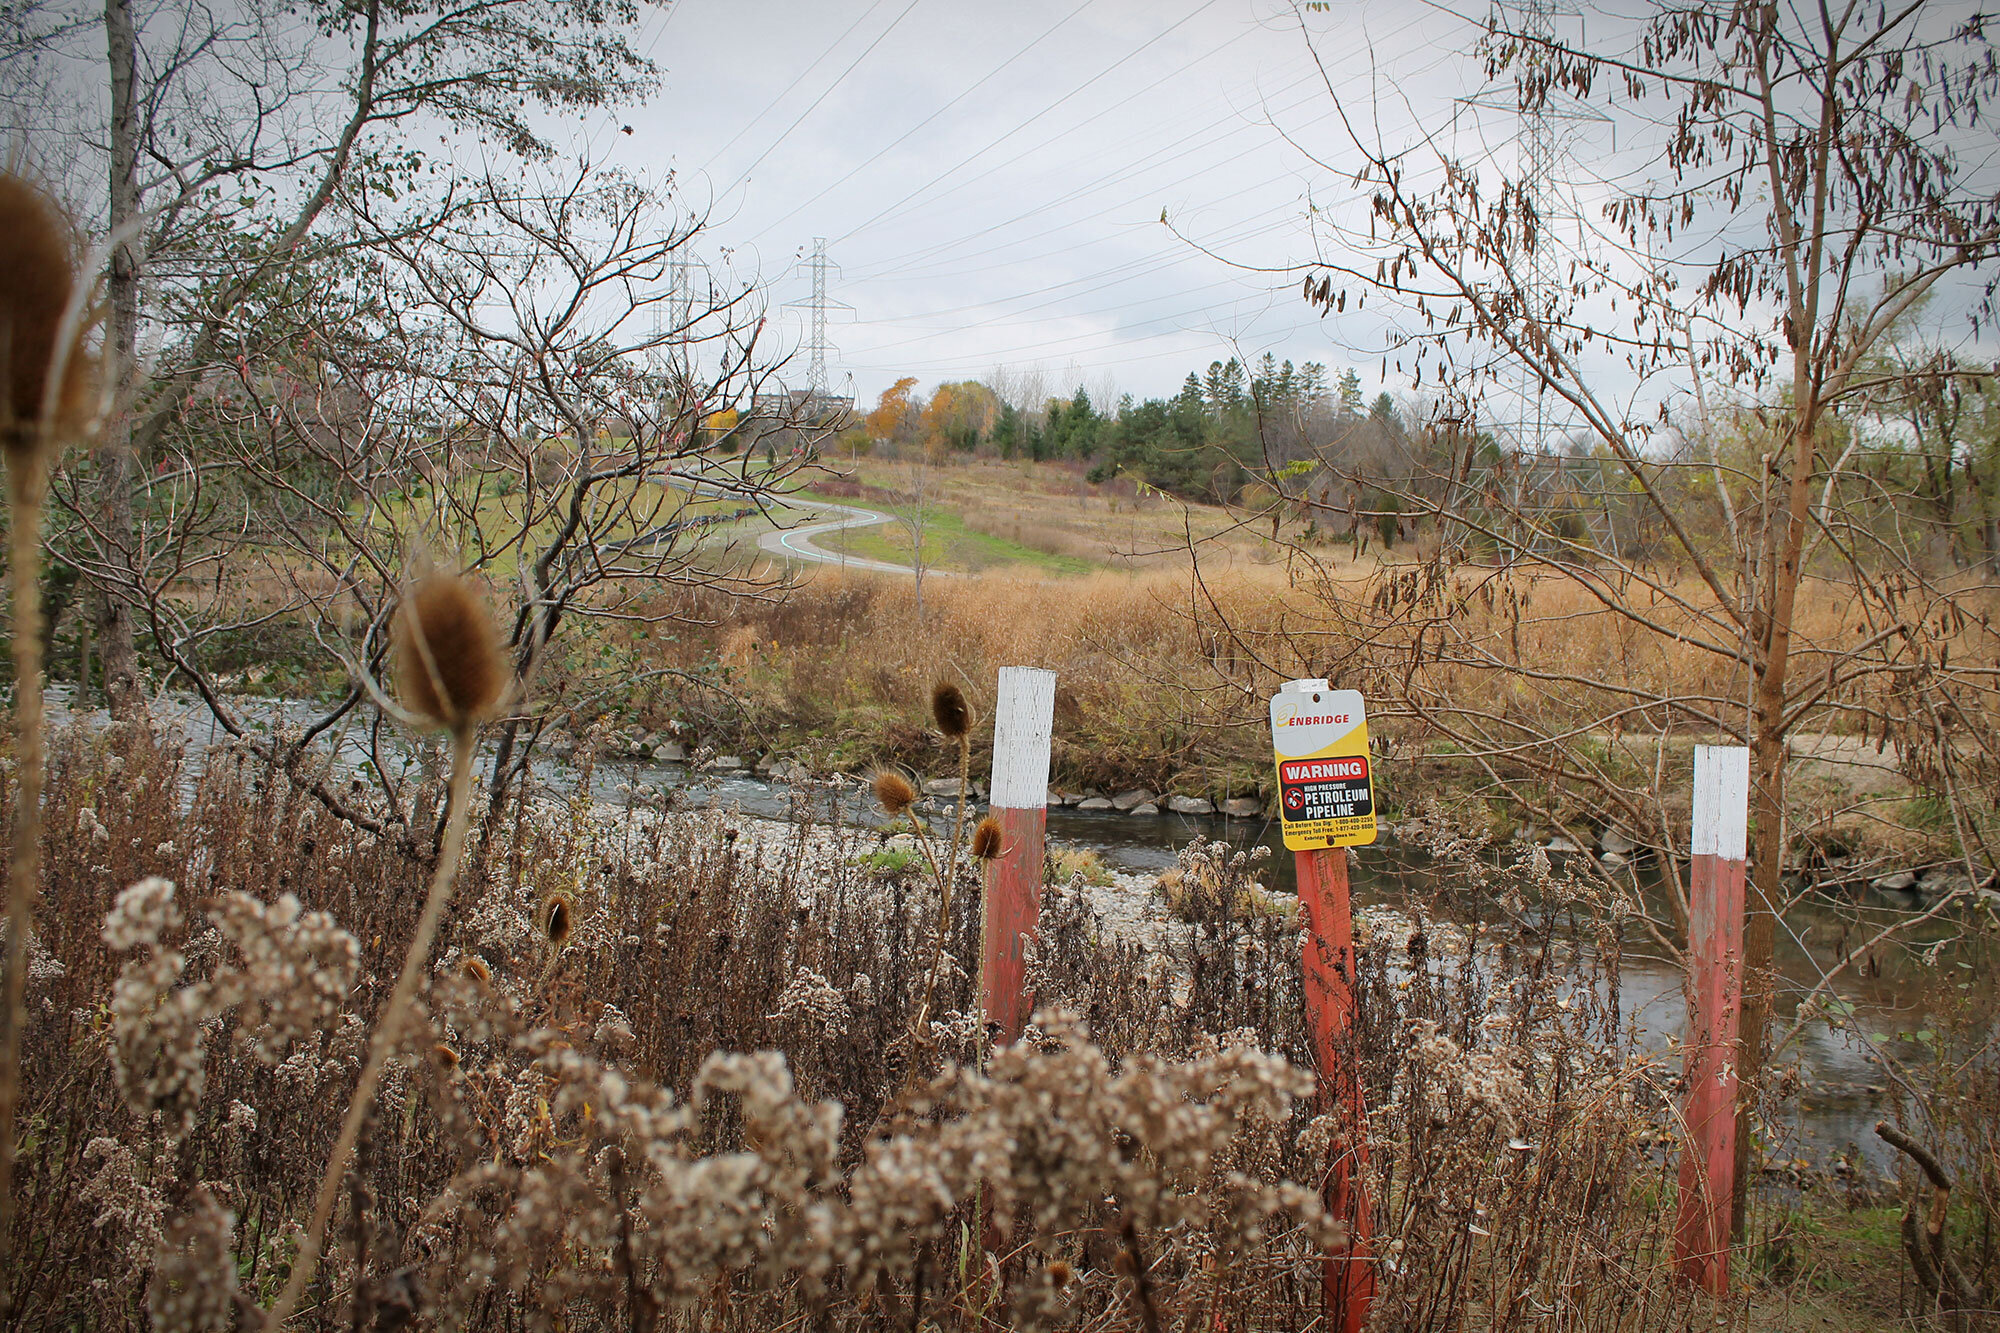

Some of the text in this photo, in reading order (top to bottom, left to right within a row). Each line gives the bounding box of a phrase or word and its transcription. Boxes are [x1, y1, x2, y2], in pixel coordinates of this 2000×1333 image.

[1289, 714, 1350, 726] ENBRIDGE
[1286, 762, 1362, 780] WARNING
[1305, 788, 1368, 806] PETROLEUM
[1306, 804, 1354, 819] PIPELINE
